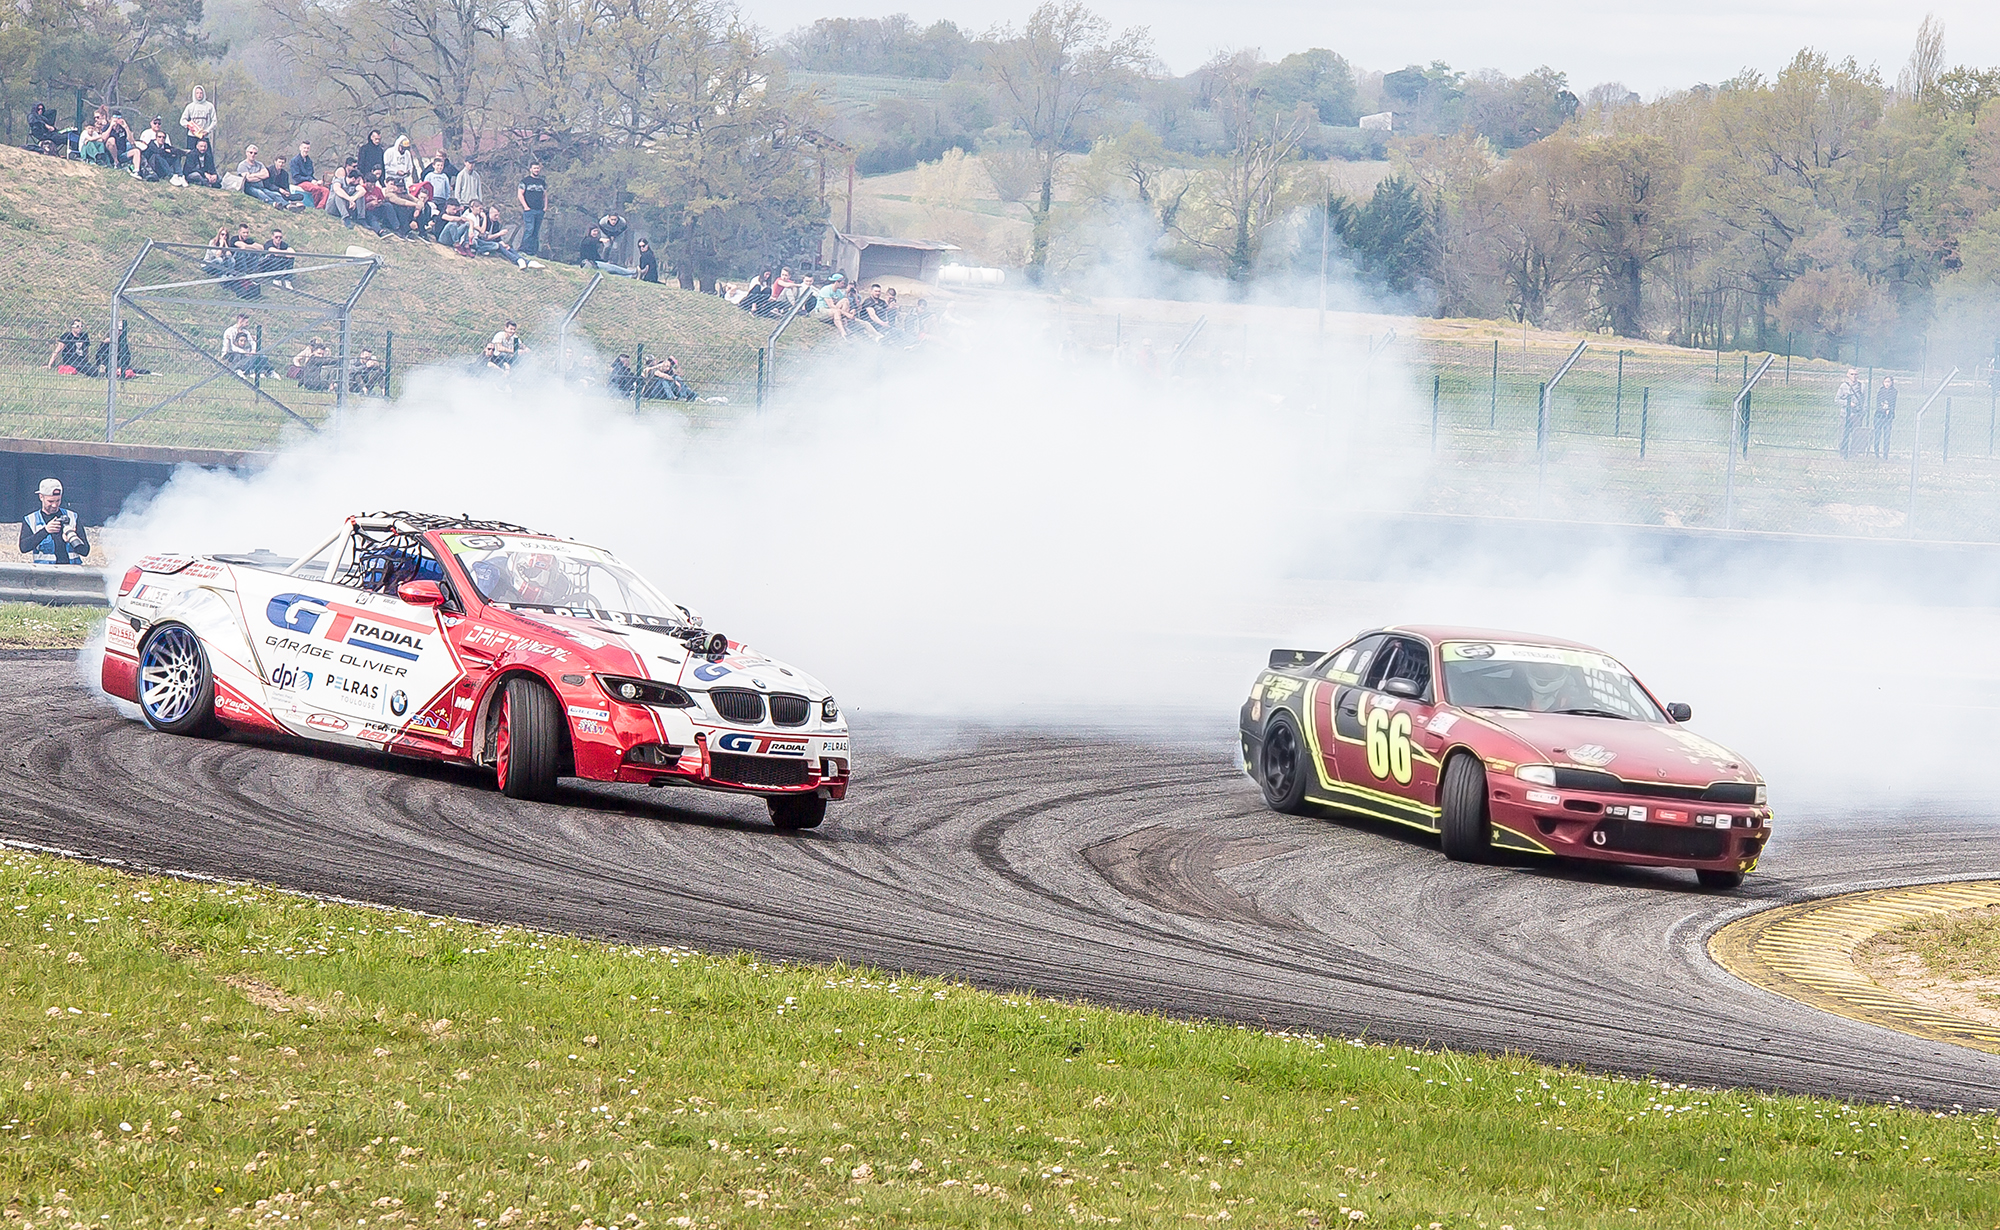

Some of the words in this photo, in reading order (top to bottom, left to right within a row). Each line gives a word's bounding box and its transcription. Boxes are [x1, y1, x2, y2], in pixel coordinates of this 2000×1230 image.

[109, 625, 135, 641] ODYSSEY
[353, 623, 423, 650] RADIAL
[266, 636, 334, 659] GARAGE
[340, 654, 408, 677] OLIVIER
[272, 663, 299, 690] dpi
[326, 674, 379, 699] PELRAS
[341, 695, 376, 710] TOULOUSE
[771, 743, 806, 751] RADIAL
[823, 741, 847, 751] PELRAS
[1367, 707, 1412, 784] 66
